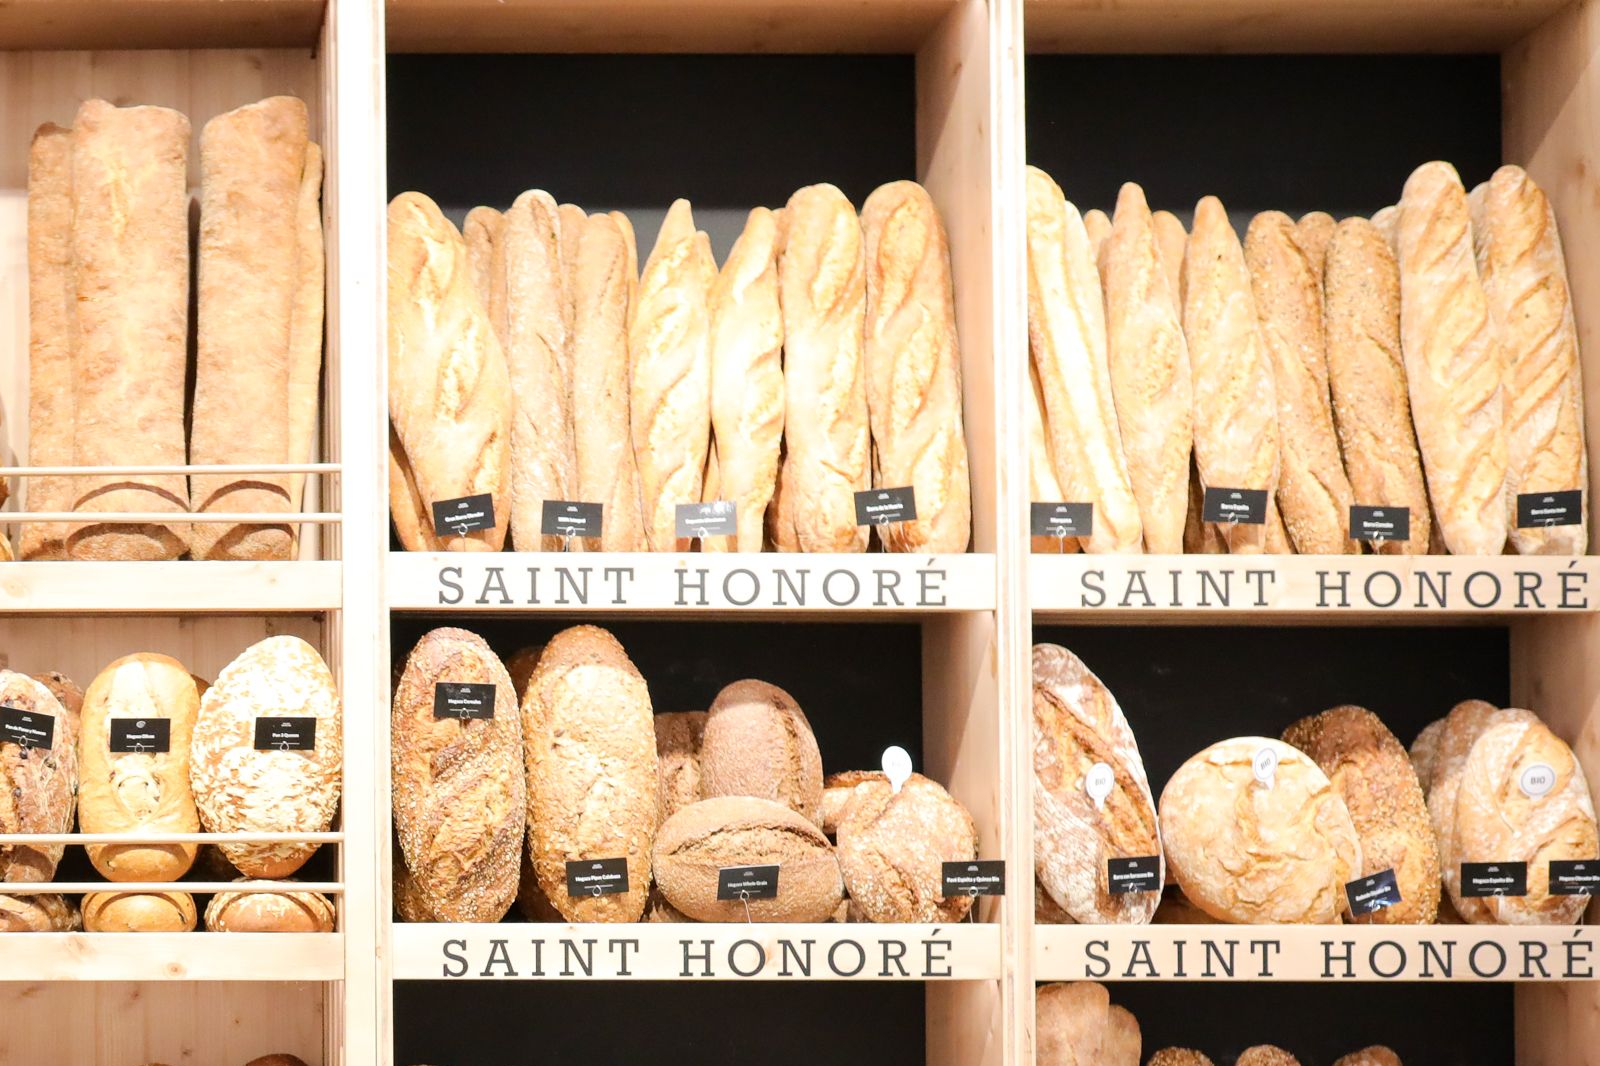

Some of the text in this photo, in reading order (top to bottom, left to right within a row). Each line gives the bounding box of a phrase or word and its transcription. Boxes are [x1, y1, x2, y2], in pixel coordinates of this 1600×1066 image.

[439, 558, 946, 606] SAINT HONORÉ
[1081, 560, 1589, 609] SAINT HONORÉ
[1530, 776, 1546, 785] BIO
[443, 928, 952, 978] SAINT HONORÉ
[1085, 928, 1594, 980] SAINT HONORÉ
